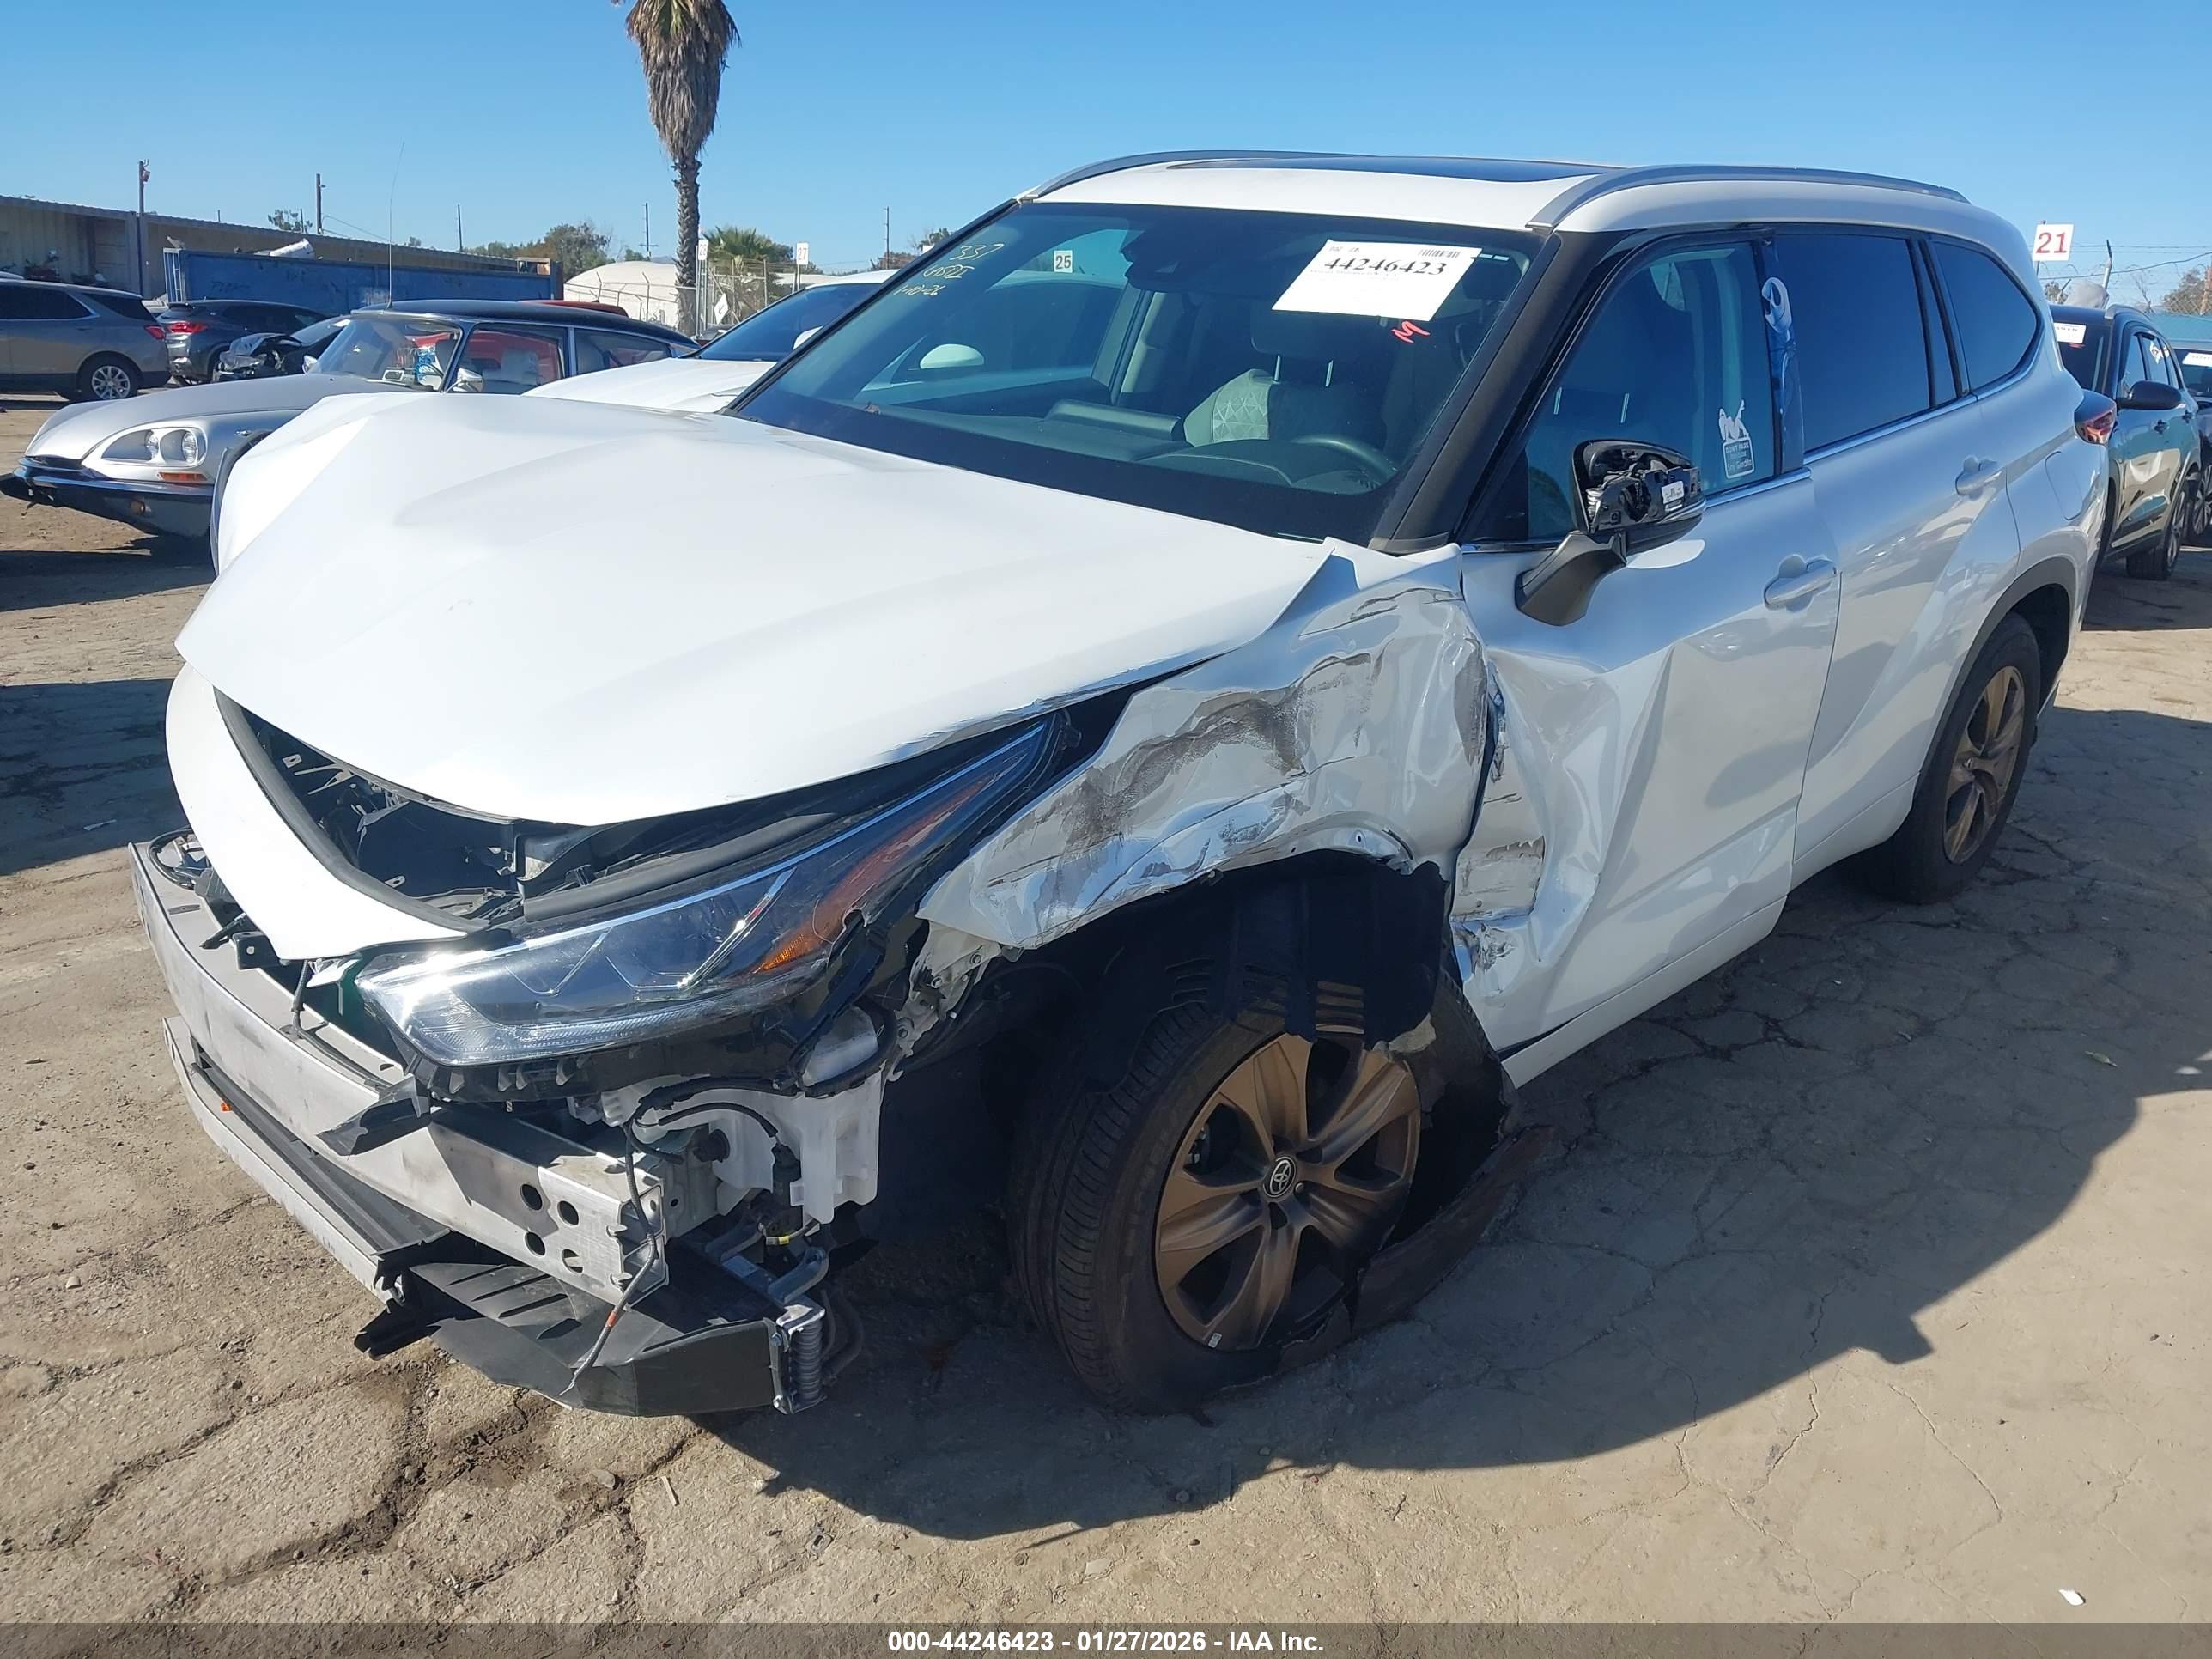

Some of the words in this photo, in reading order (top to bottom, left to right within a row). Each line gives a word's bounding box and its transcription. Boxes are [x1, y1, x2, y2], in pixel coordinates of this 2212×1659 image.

[2036, 232, 2068, 254] 21
[950, 244, 1005, 260] 337
[1055, 255, 1072, 270] 25
[1324, 257, 1447, 276] 44246423
